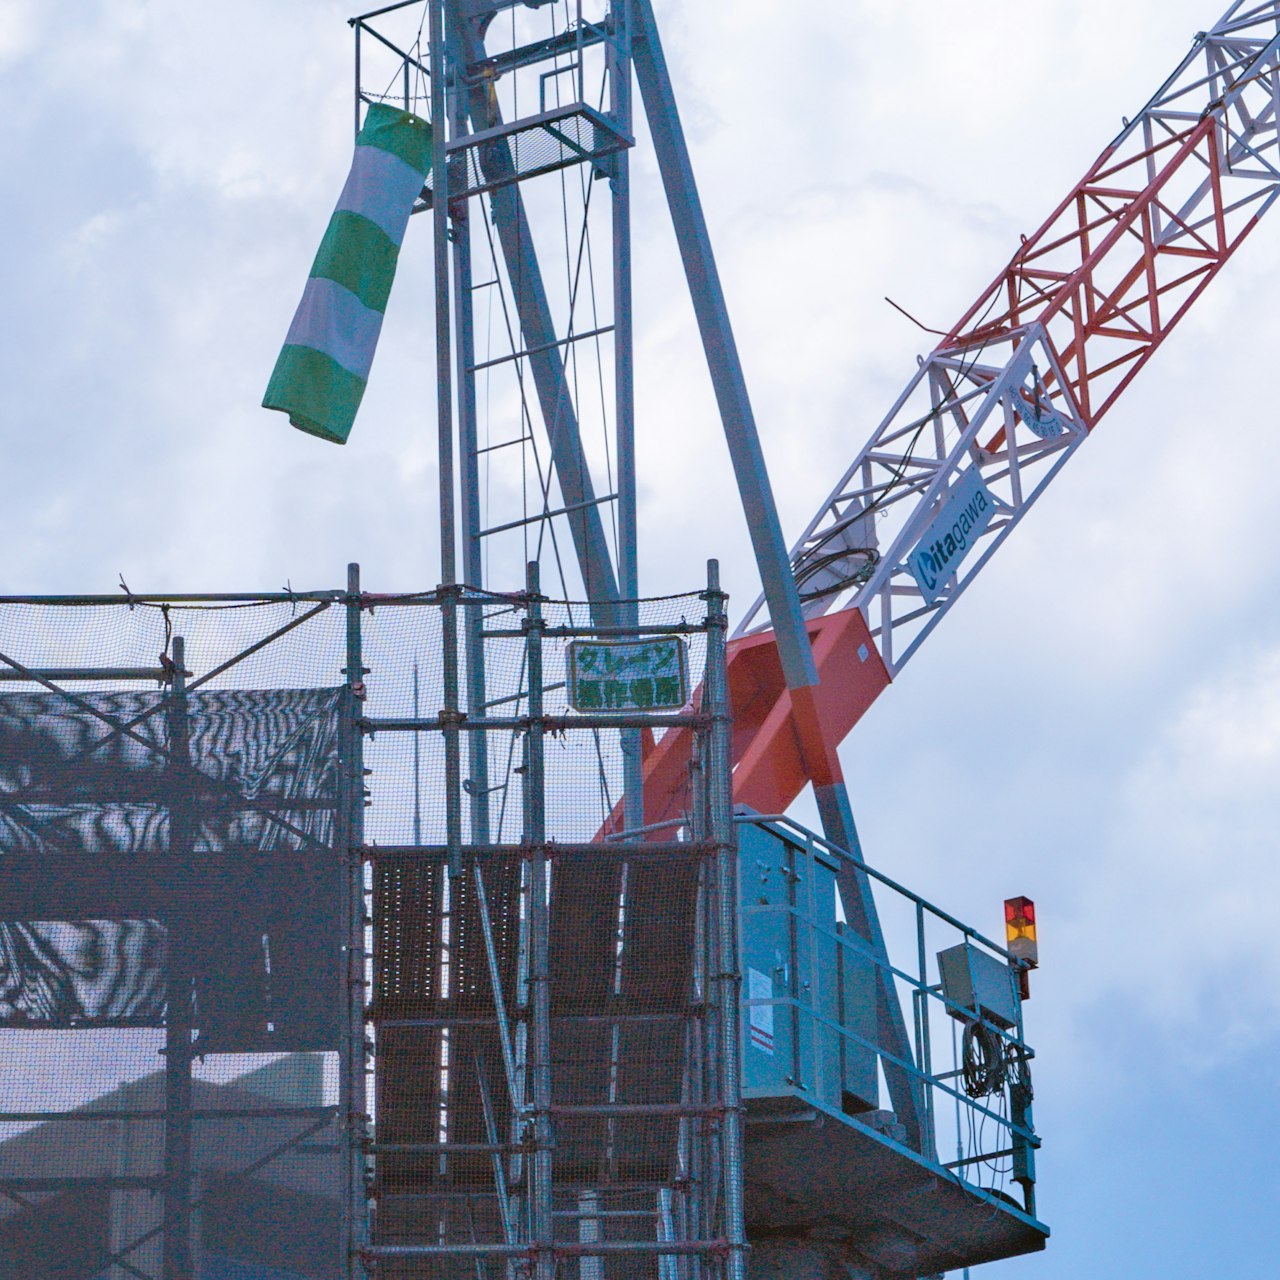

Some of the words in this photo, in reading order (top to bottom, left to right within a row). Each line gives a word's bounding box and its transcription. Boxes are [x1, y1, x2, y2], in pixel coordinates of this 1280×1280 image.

[918, 490, 989, 590] Kitagawa
[577, 645, 676, 673] クレーン
